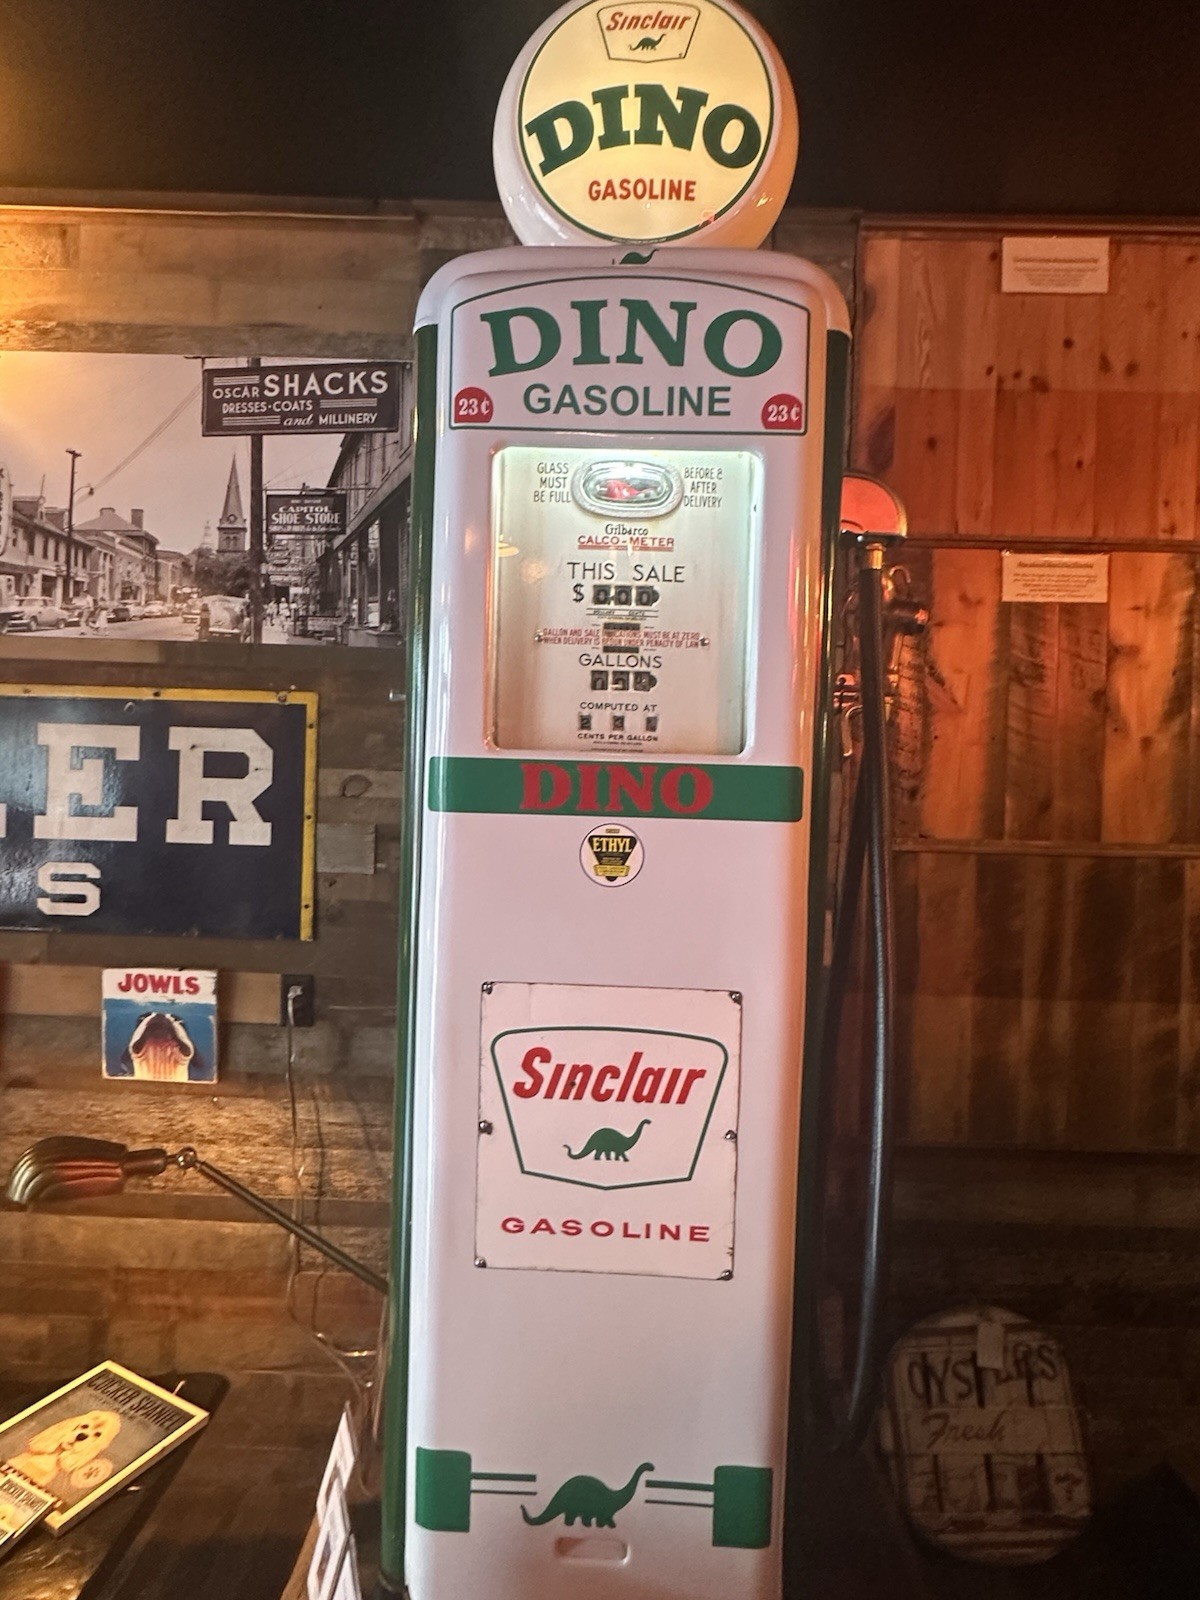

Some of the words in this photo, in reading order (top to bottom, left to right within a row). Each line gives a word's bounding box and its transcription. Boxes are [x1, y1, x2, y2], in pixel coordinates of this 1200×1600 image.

[606, 10, 692, 31] Sinclair
[524, 84, 762, 177] DINO
[588, 178, 697, 201] GASOLINE
[480, 298, 783, 378] DINO
[212, 386, 260, 399] OSCAR
[263, 370, 389, 397] SHACKS
[458, 396, 491, 416] 23¢
[523, 383, 732, 417] GASOLINE
[283, 414, 314, 426] and
[318, 413, 378, 426] MILLINERY
[767, 404, 800, 422] 23¢
[536, 462, 569, 474] GLASS
[684, 467, 716, 480] BEFORE
[539, 477, 567, 489] MUST
[690, 481, 717, 494] AFTER
[533, 490, 546, 502] BE
[549, 491, 571, 503] FULL
[683, 495, 723, 508] DELIVERY
[278, 505, 332, 513] CAPITOL
[271, 512, 300, 525] SHOE
[304, 512, 341, 525] STORE
[577, 535, 675, 547] CALCO-METER
[567, 561, 615, 580] THIS
[632, 564, 686, 583] SALE
[572, 582, 585, 602] $
[578, 653, 663, 669] GALLONS
[579, 701, 639, 712] COMPUTED
[643, 704, 658, 713] AT
[608, 733, 624, 741] PER
[626, 734, 659, 742] GALLON
[519, 763, 714, 814] DINO
[592, 837, 632, 853] ETHYL
[118, 972, 200, 996] JOWLS
[512, 1047, 707, 1105] Sinclair
[500, 1217, 711, 1242] GASOLINE
